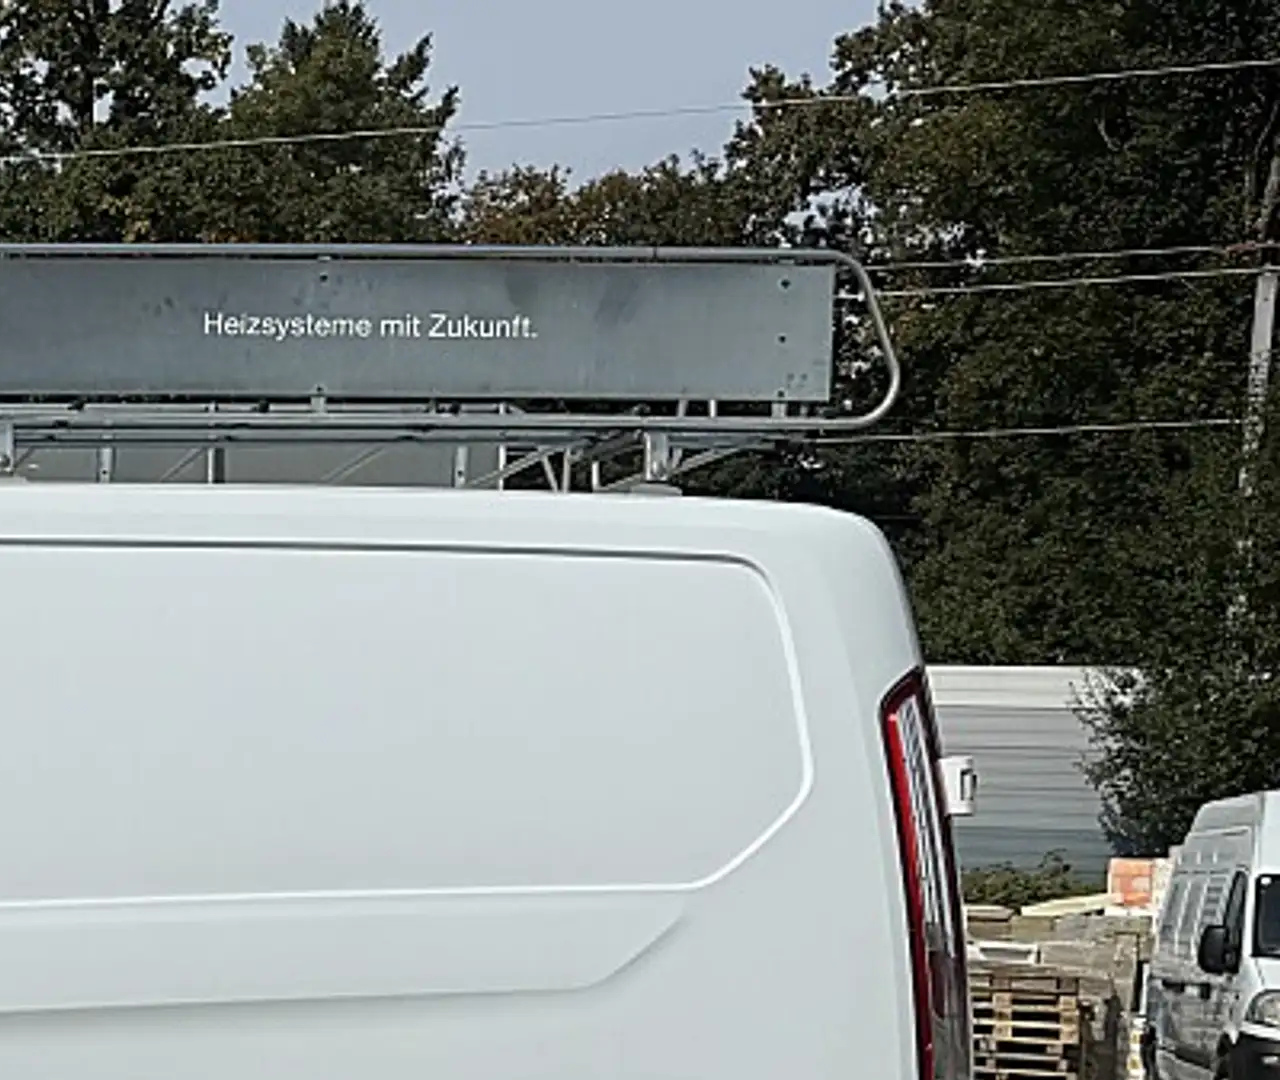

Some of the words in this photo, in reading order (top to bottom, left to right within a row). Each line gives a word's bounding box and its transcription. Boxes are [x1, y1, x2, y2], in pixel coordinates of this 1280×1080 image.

[203, 311, 371, 342] Heizsysteme
[380, 313, 421, 338] mit
[428, 312, 539, 340] Zukunft.
